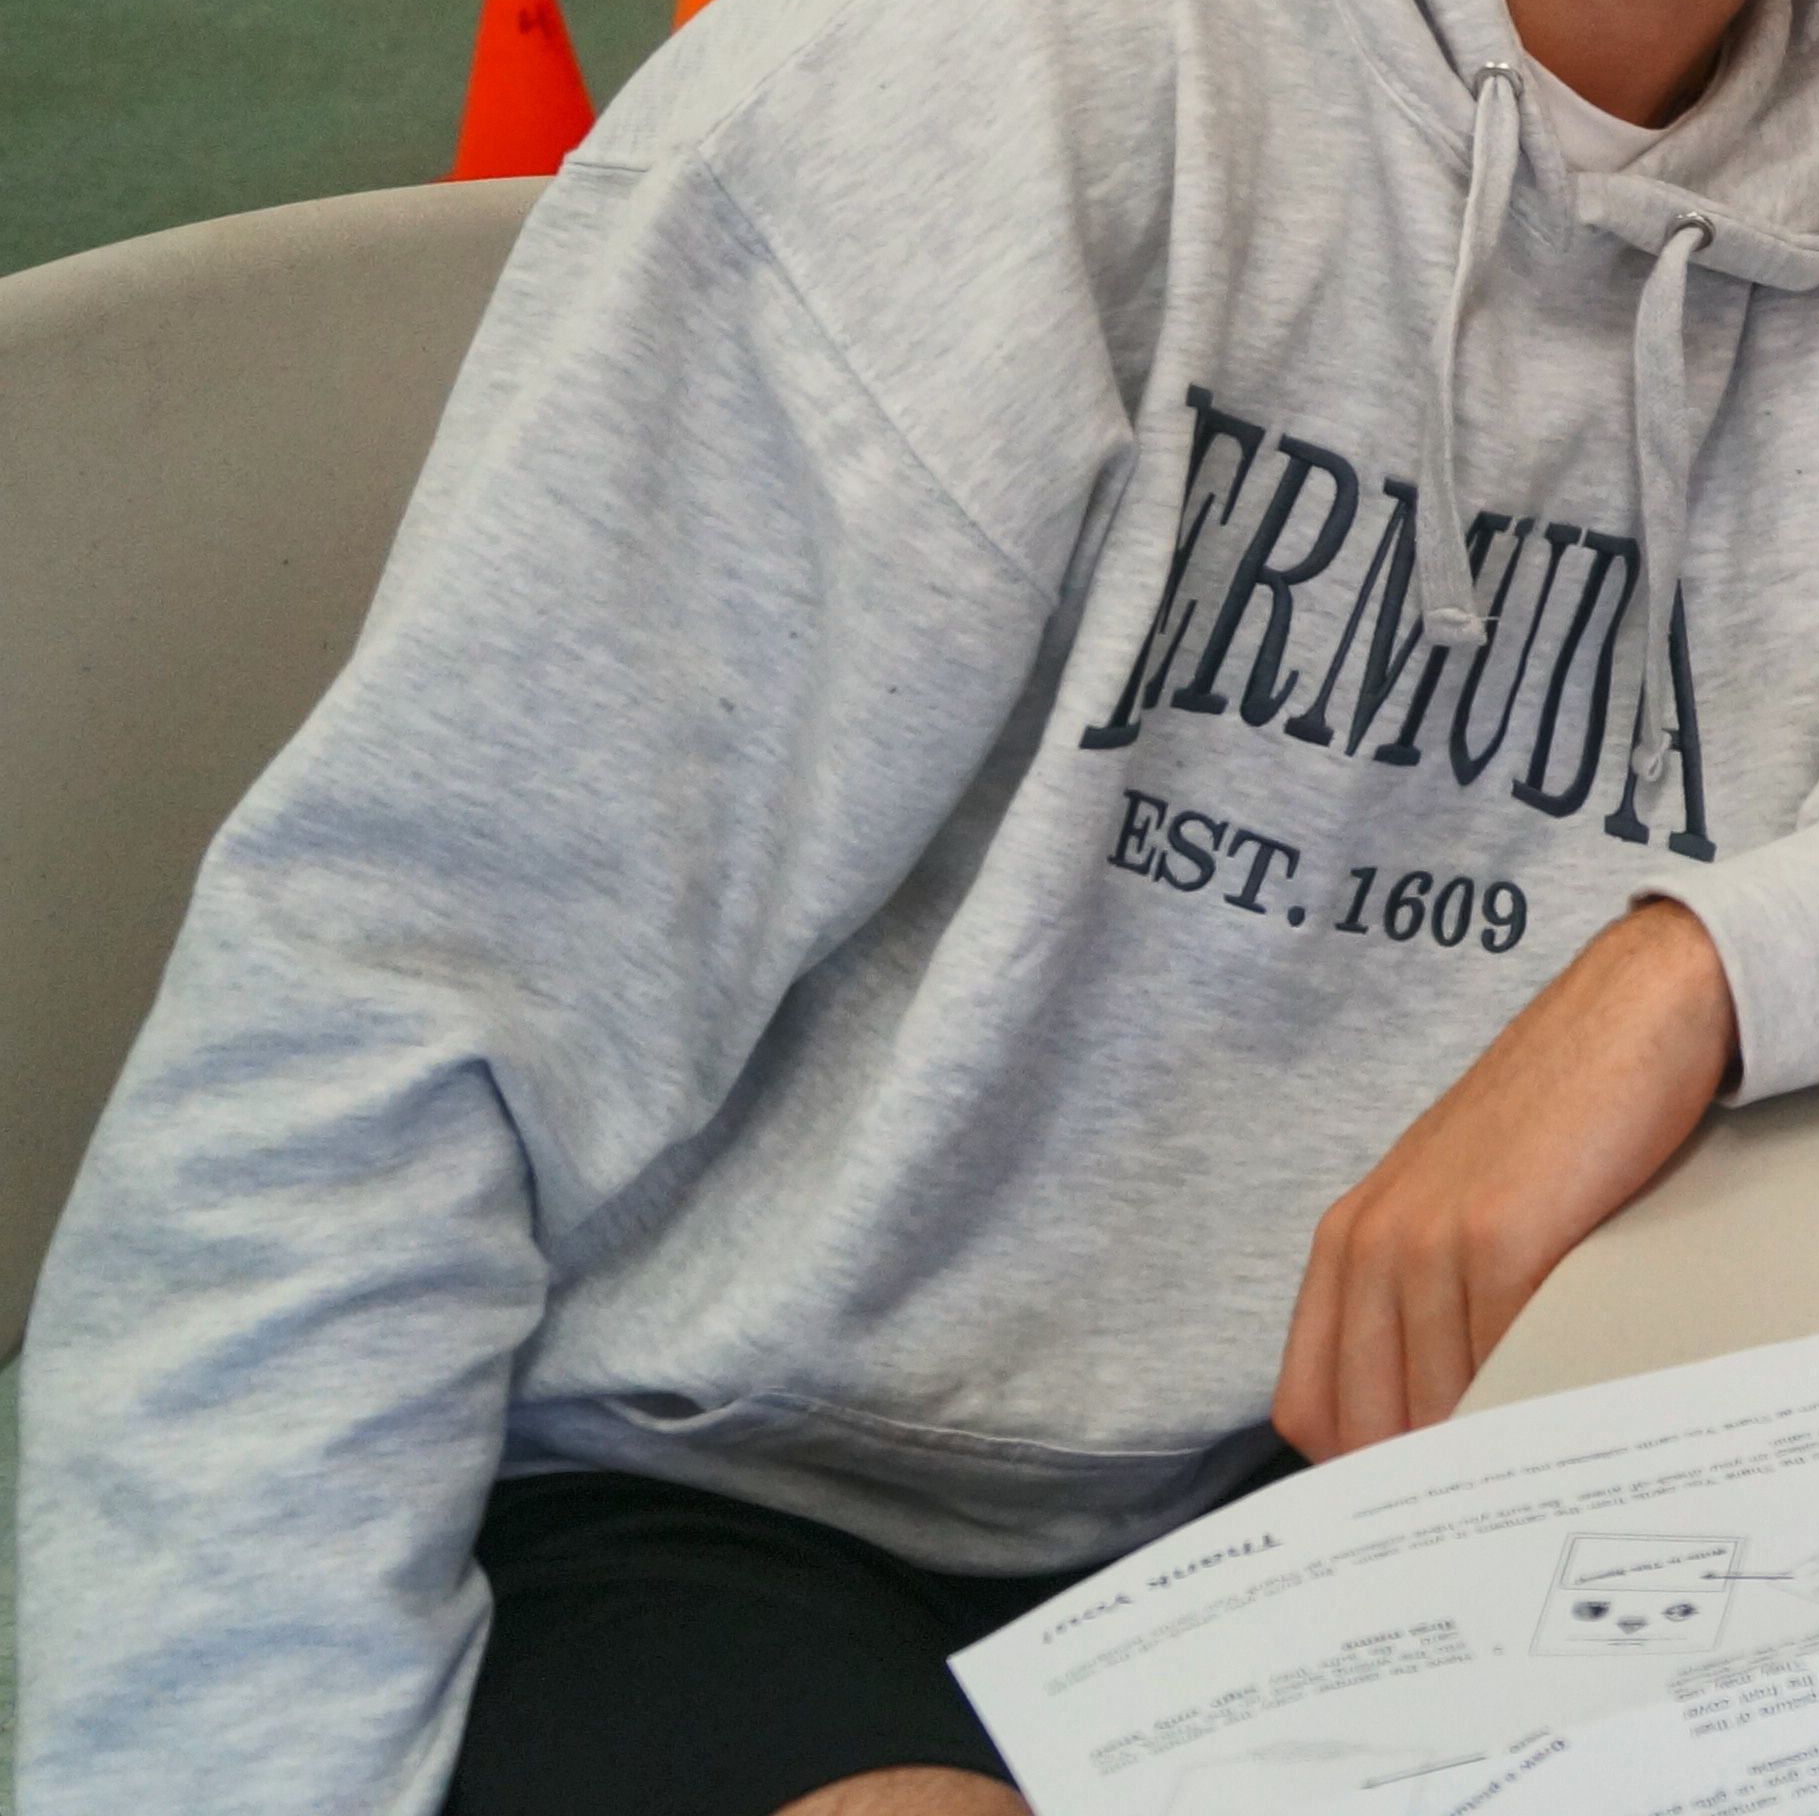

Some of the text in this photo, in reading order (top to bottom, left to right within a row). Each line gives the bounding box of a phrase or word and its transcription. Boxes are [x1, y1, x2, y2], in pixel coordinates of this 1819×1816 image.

[1080, 384, 1716, 862] ERMUDA
[1107, 789, 1528, 954] EST. 1609
[1040, 1532, 1283, 1643] Thank You!
